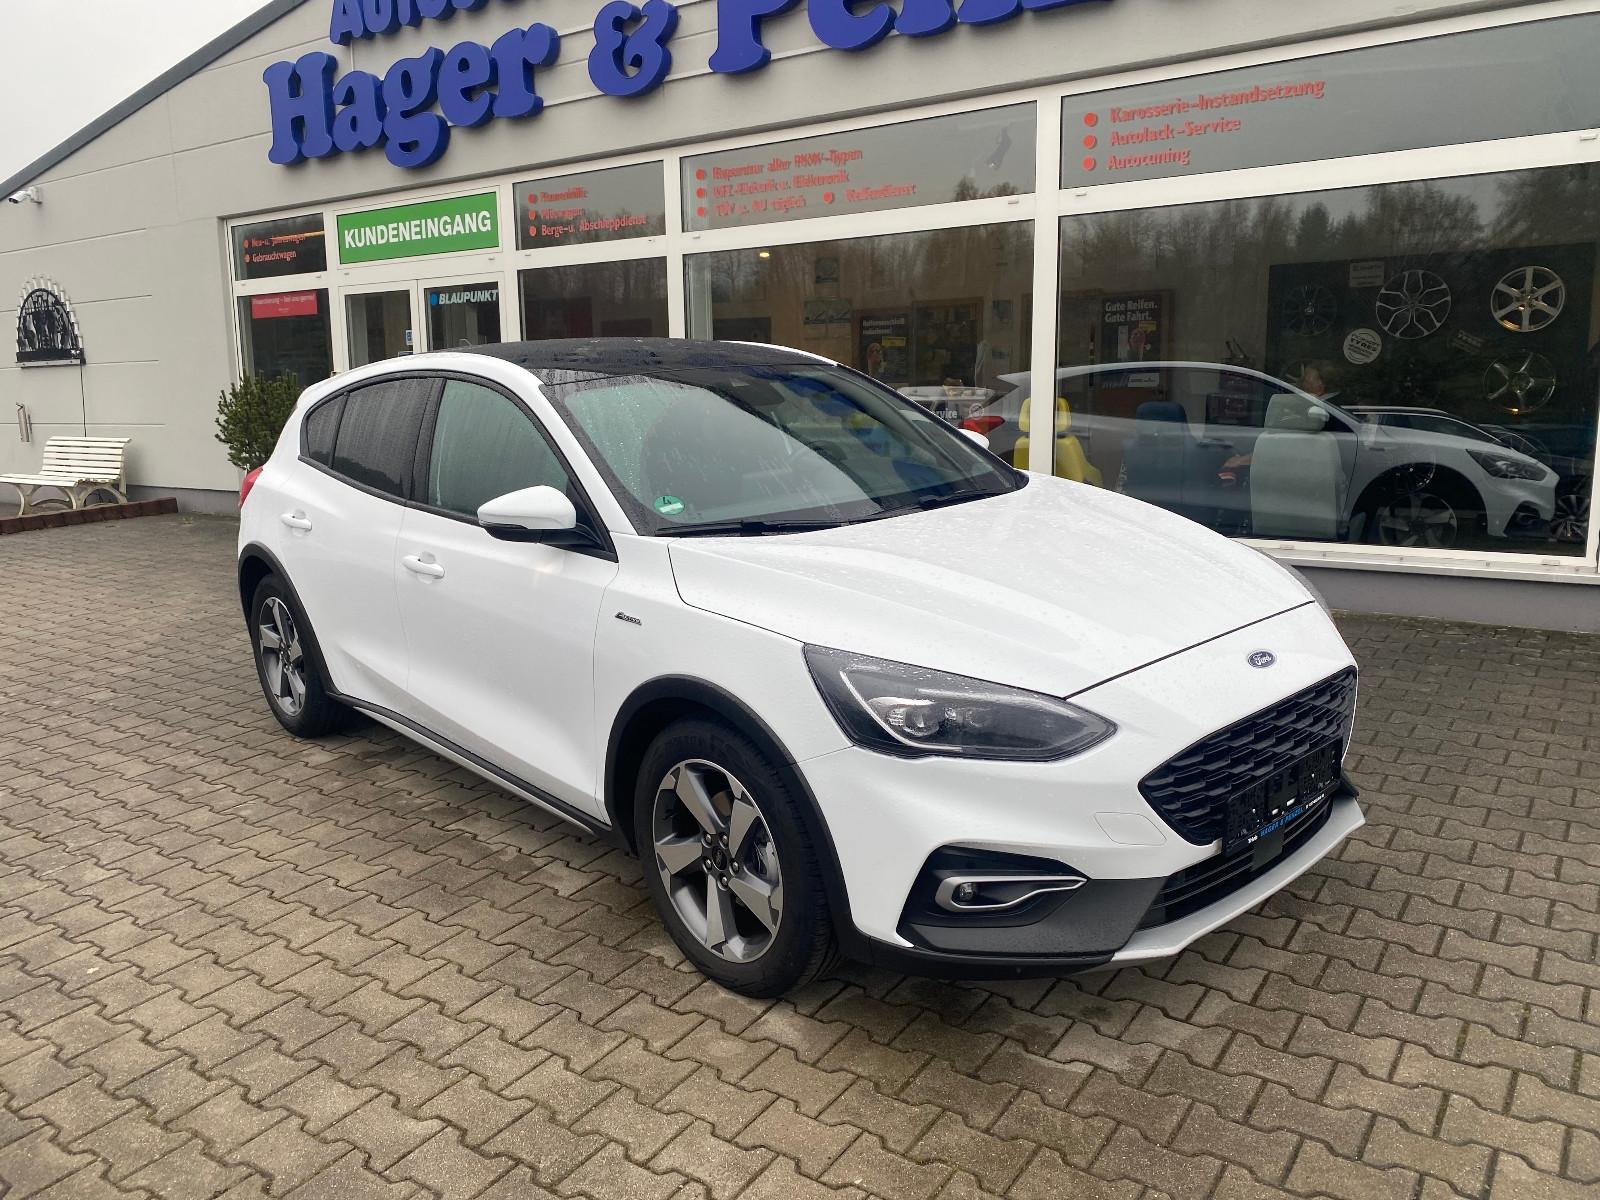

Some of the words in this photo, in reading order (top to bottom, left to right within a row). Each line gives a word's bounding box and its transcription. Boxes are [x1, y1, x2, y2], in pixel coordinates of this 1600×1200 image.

[263, 22, 560, 169] Hager
[588, 0, 679, 97] &
[1110, 79, 1325, 124] Karosserie-Instandsetzung
[343, 210, 492, 249] KUNDENEINGANG
[438, 289, 499, 305] BLAUPUNKT
[1105, 301, 1126, 312] Gute
[1104, 313, 1126, 322] Gute
